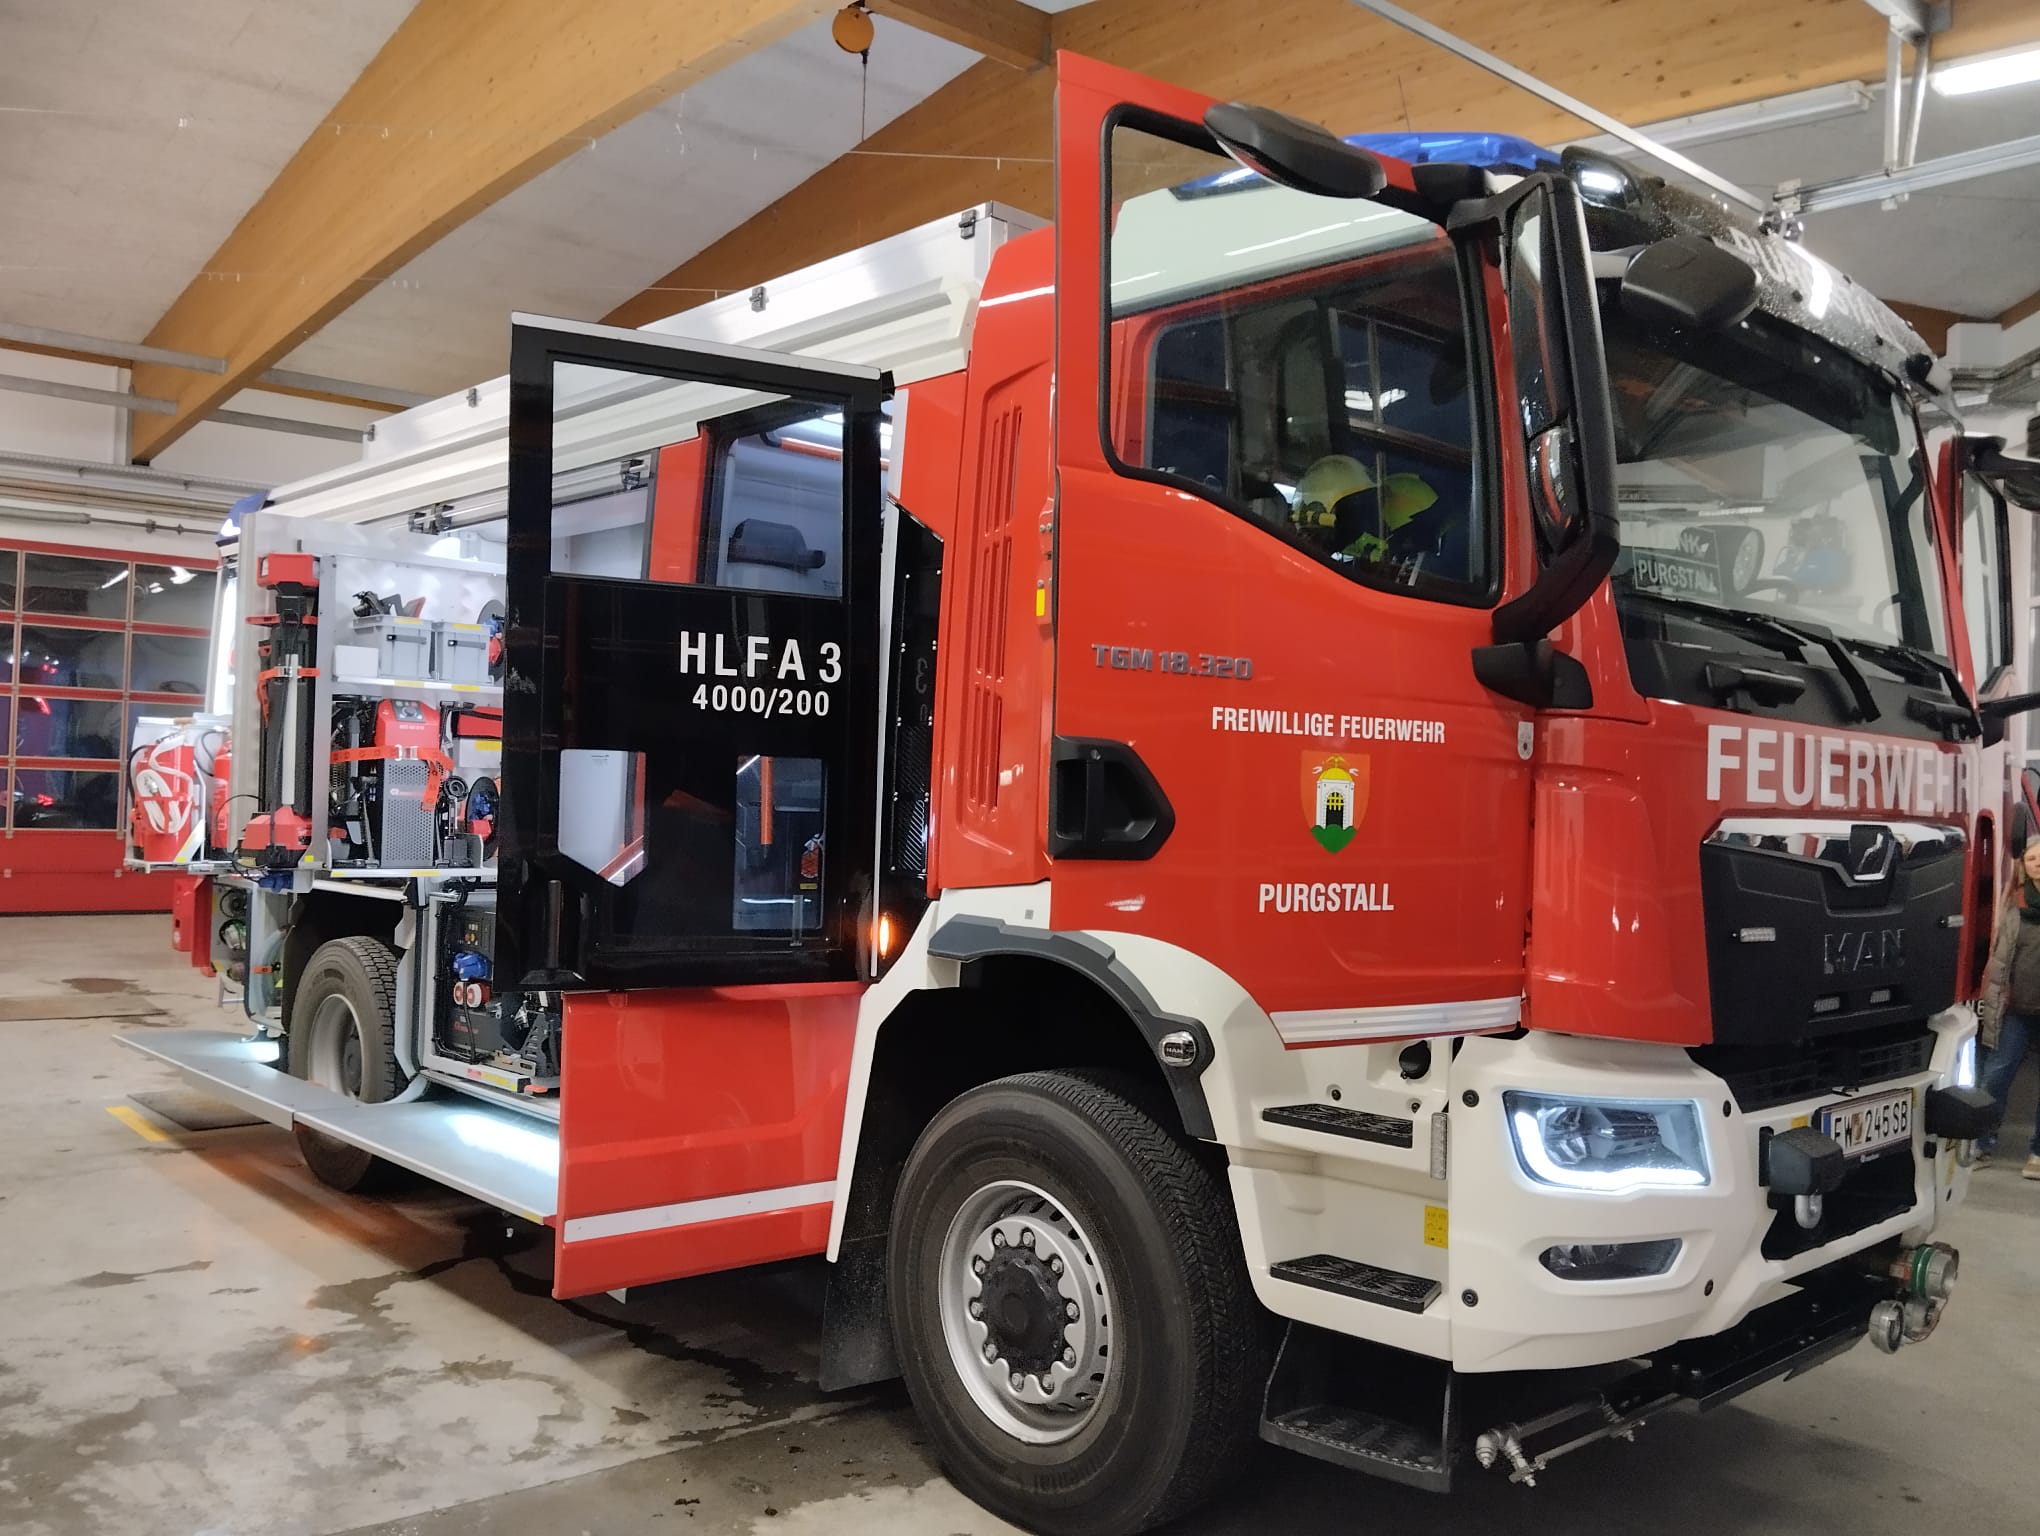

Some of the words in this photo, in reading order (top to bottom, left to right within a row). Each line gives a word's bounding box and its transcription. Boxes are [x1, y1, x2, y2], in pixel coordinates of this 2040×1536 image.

[680, 631, 806, 680] HLFA
[819, 642, 842, 683] 3
[1091, 643, 1153, 672] TGM
[1159, 651, 1253, 680] 18.320
[692, 684, 829, 719] 4000/200
[1212, 706, 1334, 737] FREIWILLIGE
[1340, 715, 1446, 744] FEUERWEHR
[1706, 724, 1974, 818] FEUERWEHR
[1258, 882, 1395, 913] PURGSTALL
[1824, 928, 1905, 975] MAN
